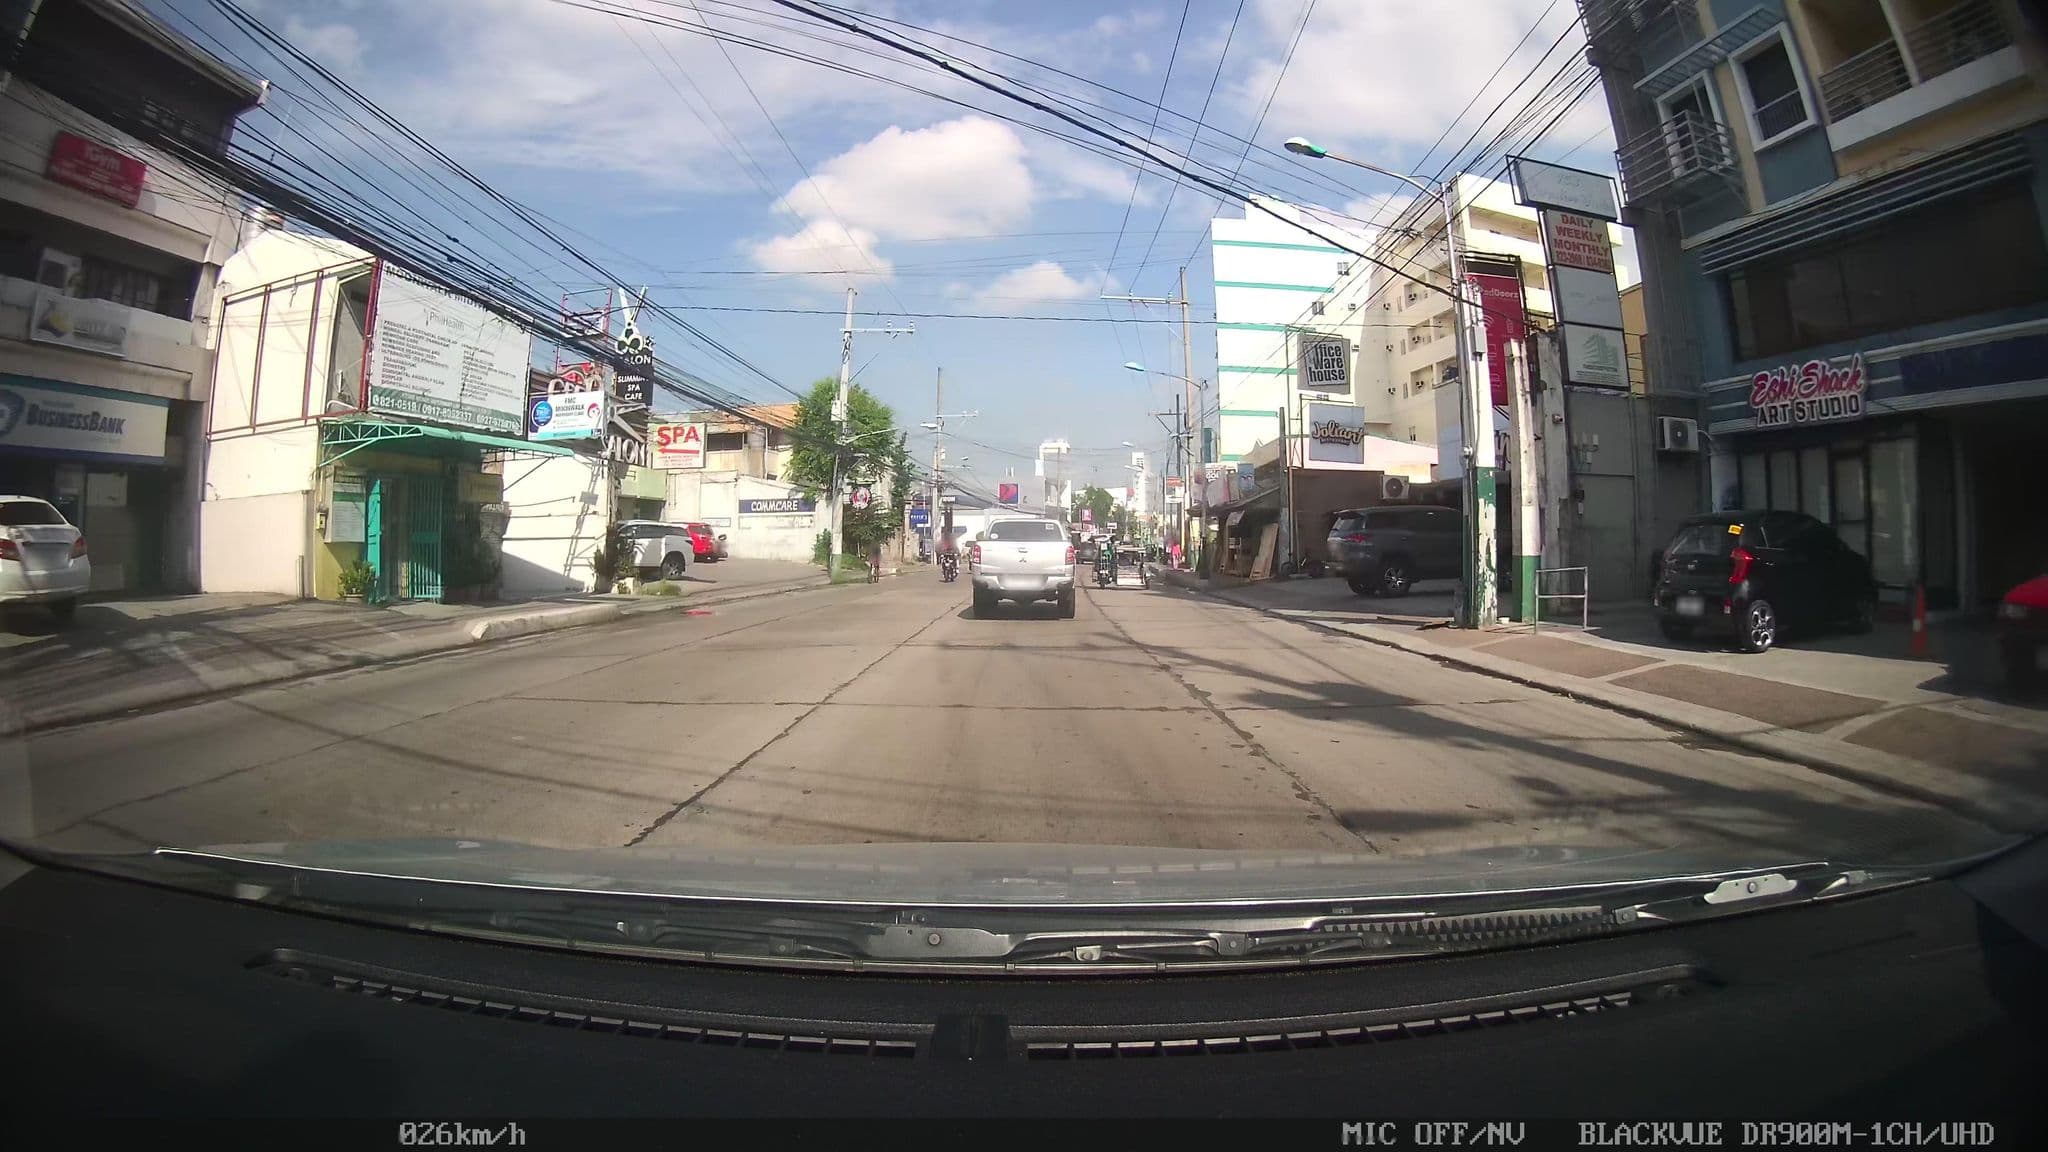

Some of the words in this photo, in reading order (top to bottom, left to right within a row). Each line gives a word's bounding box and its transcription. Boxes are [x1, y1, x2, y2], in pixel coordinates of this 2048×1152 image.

[1561, 214, 1594, 228] DAILY
[1555, 225, 1603, 243] WEEKLY
[1554, 238, 1609, 257] MONTHLY
[1308, 366, 1346, 382] house
[1798, 353, 1864, 399] Shack
[624, 392, 643, 400] CAFE
[627, 384, 641, 392] SPA
[1757, 403, 1790, 426] ART
[1794, 394, 1860, 422] STUDIO
[657, 425, 700, 446] SPA
[751, 500, 799, 512] COMMCARE
